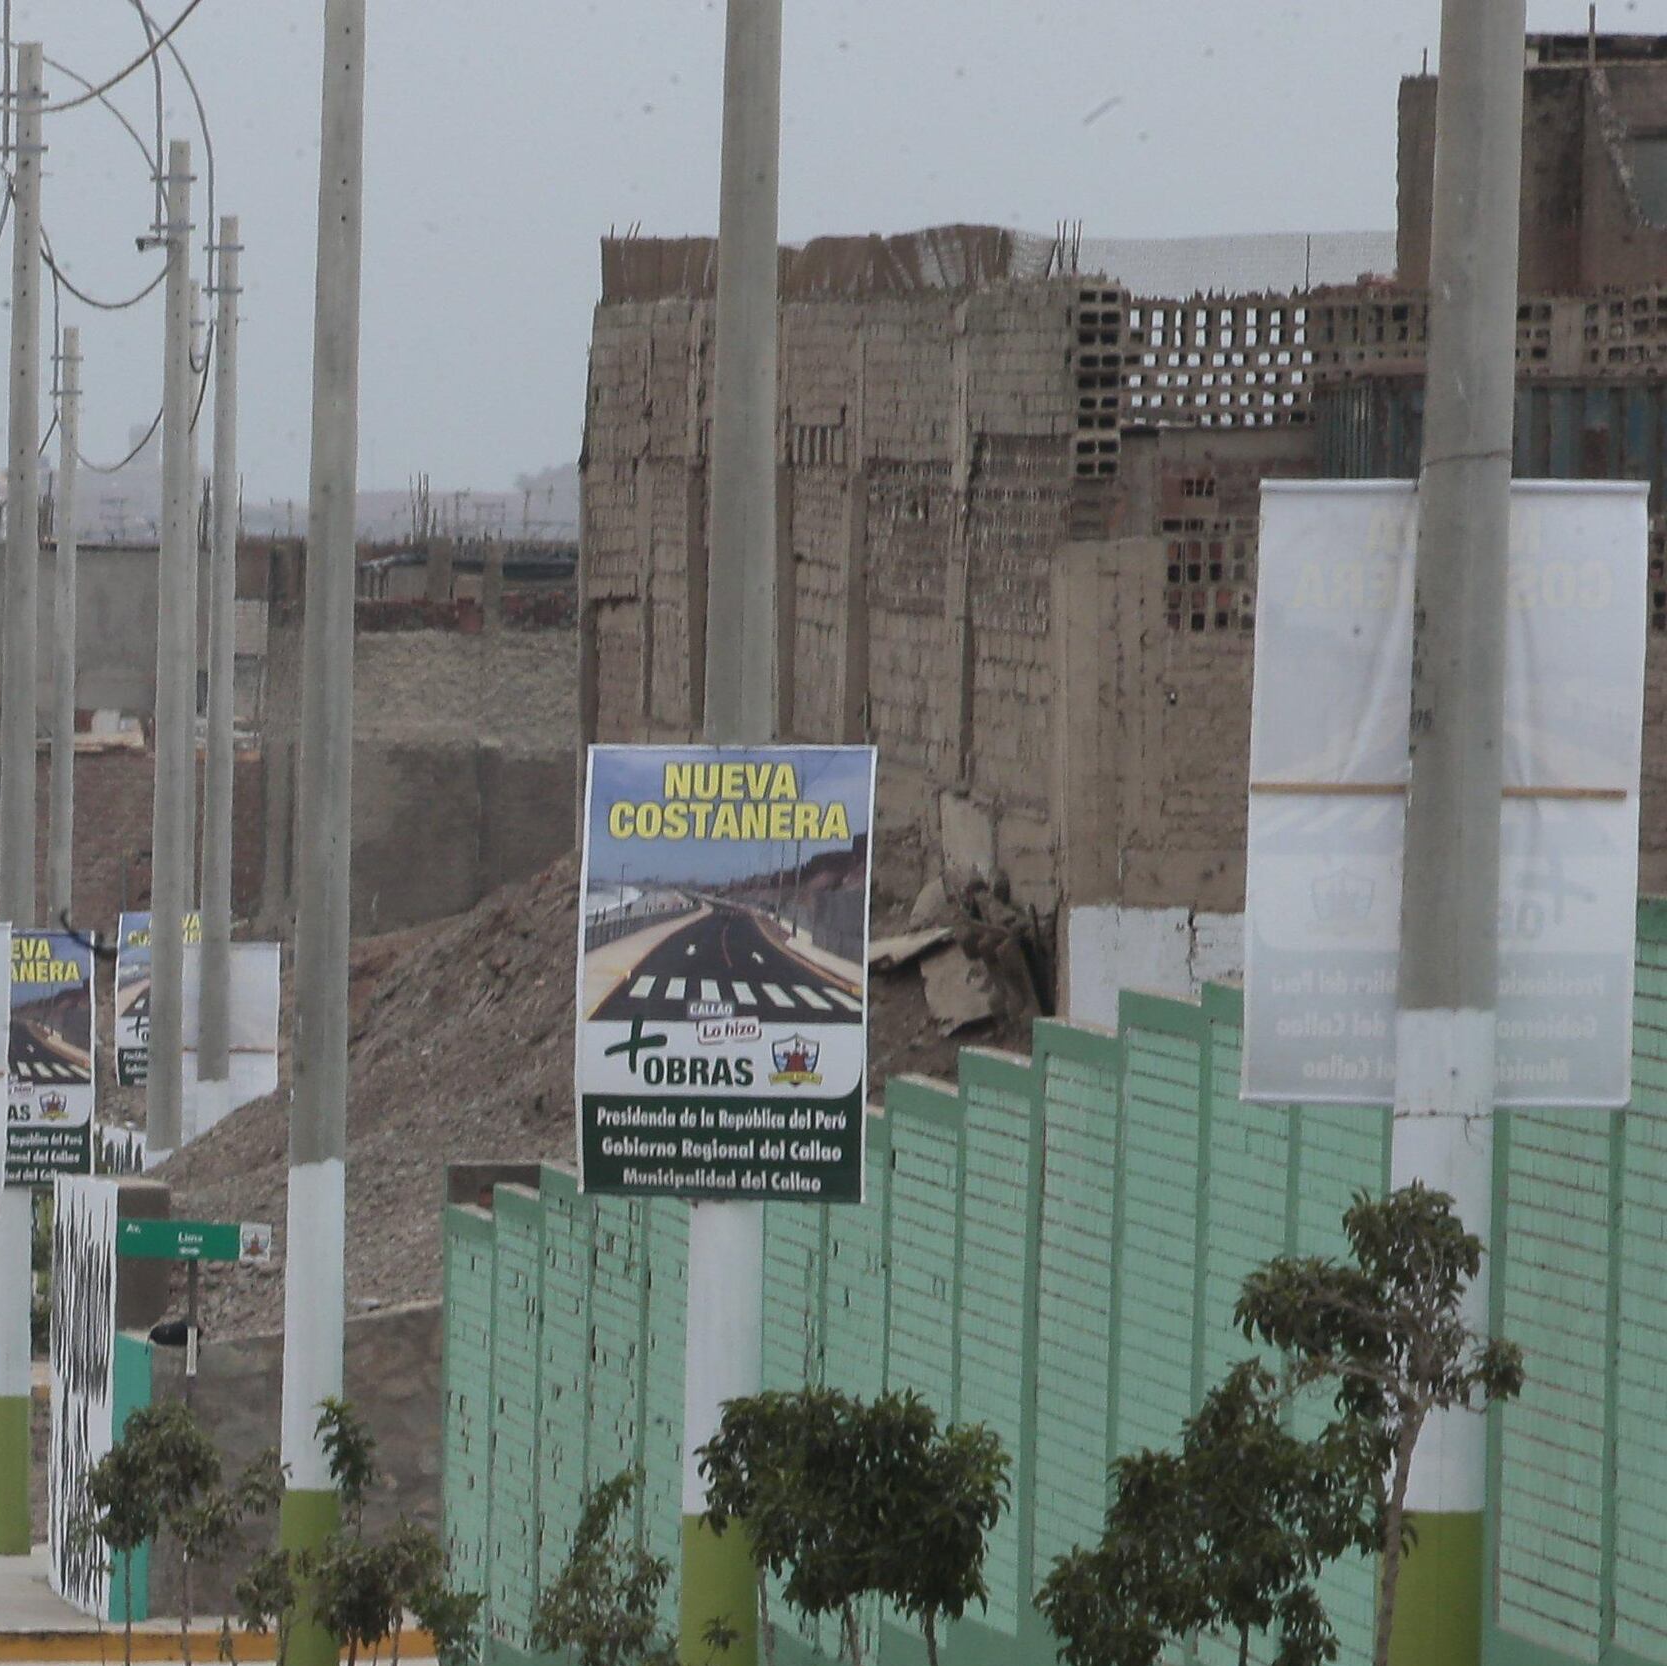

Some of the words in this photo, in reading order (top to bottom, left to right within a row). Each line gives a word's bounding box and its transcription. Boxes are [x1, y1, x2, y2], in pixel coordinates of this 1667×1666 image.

[664, 762, 798, 799] NUEVA
[609, 801, 850, 840] COSTANERA
[11, 938, 51, 961] EVA
[11, 960, 80, 983] ANERA
[690, 1002, 734, 1016] CALLAO
[702, 1024, 722, 1039] Lo
[724, 1021, 758, 1038] hizo
[643, 1057, 754, 1087] OBRAS
[596, 1106, 676, 1128] Presidencia
[679, 1107, 696, 1128] de
[700, 1107, 713, 1128] la
[718, 1108, 785, 1131] República
[788, 1108, 811, 1130] del
[814, 1110, 847, 1130] Perú
[601, 1136, 677, 1157] Gobierno
[681, 1137, 754, 1162] Regional
[759, 1138, 785, 1160] del
[789, 1140, 842, 1162] Callao
[623, 1168, 736, 1190] Municipalidad
[740, 1170, 767, 1190] del
[770, 1171, 822, 1194] Callao
[177, 1231, 203, 1244] Lima
